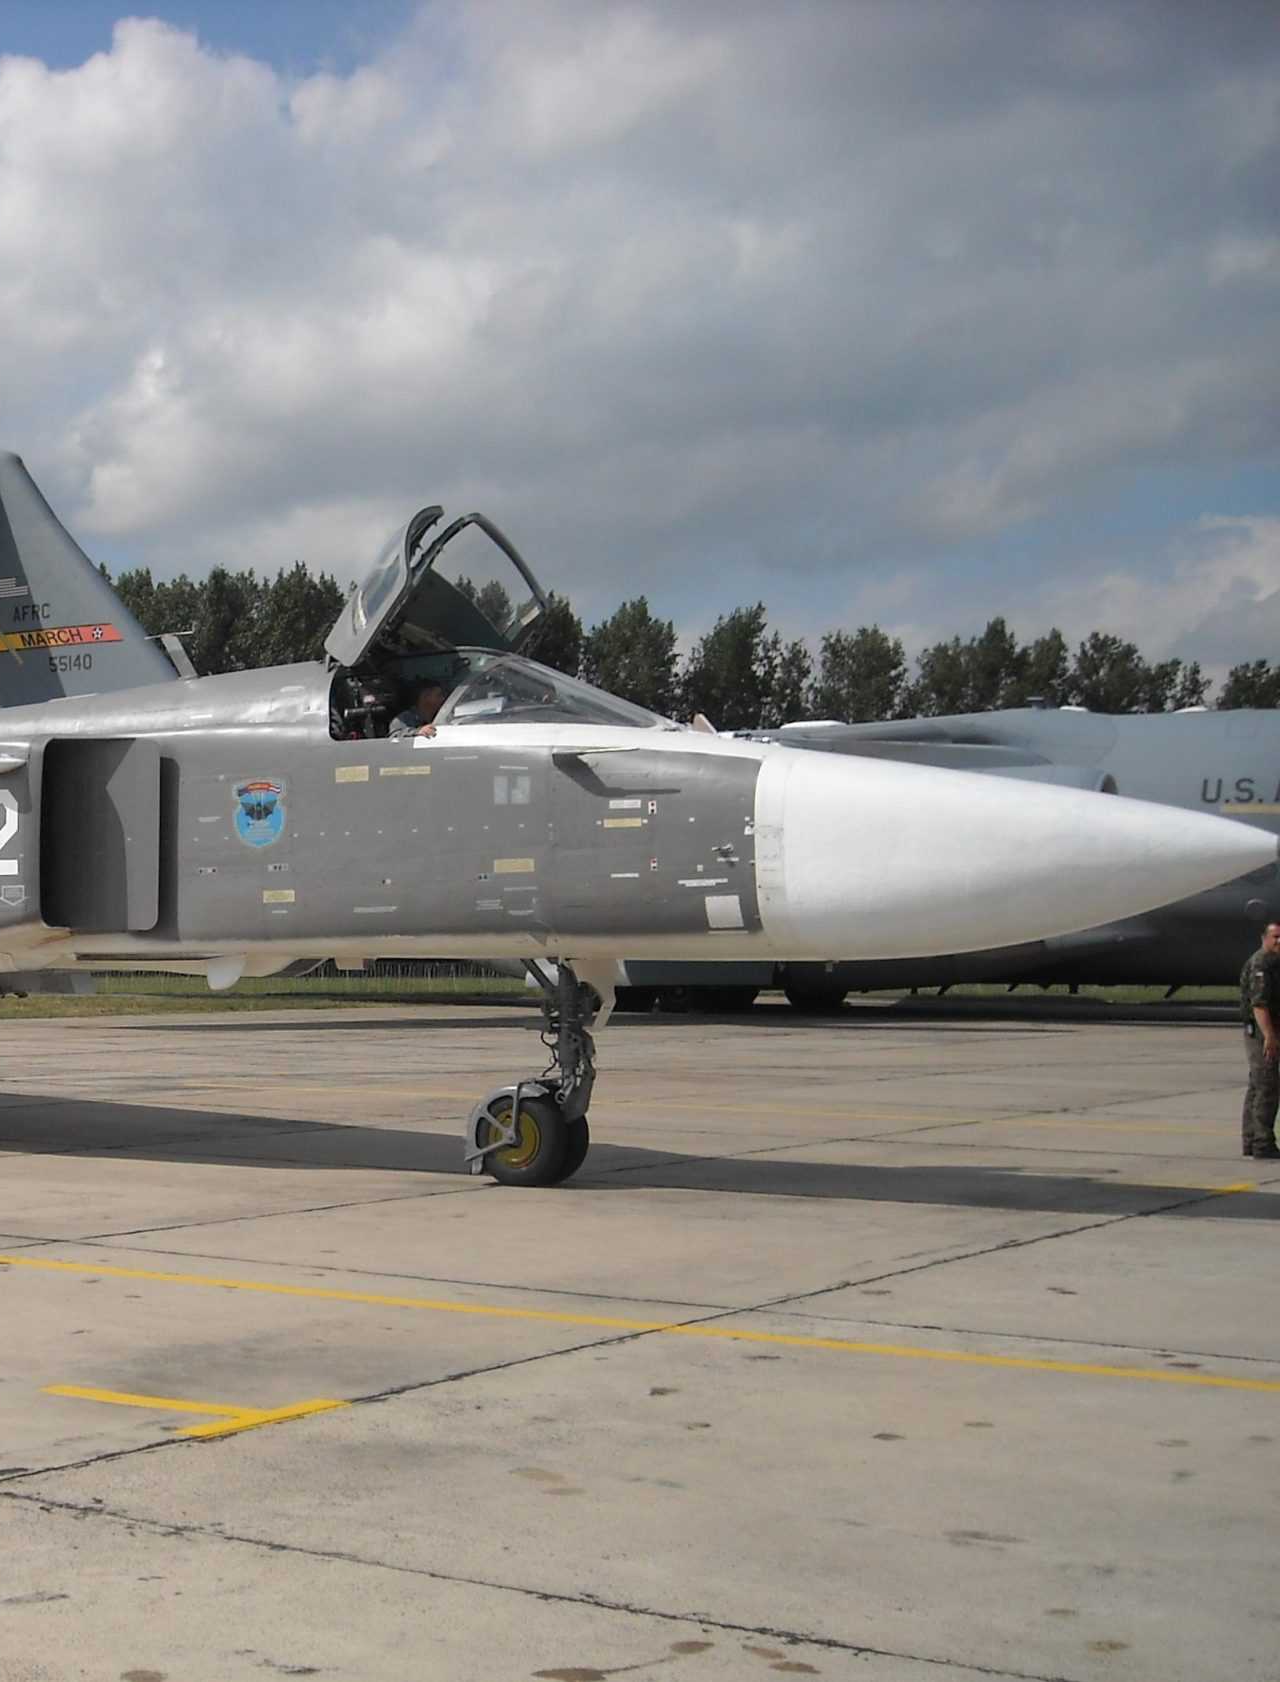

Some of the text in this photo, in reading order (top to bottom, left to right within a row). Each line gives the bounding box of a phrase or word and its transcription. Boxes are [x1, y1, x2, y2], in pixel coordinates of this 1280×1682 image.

[14, 603, 50, 622] AFRC
[20, 628, 83, 647] MARCH
[48, 653, 92, 673] 55140
[1201, 777, 1264, 803] U.S.
